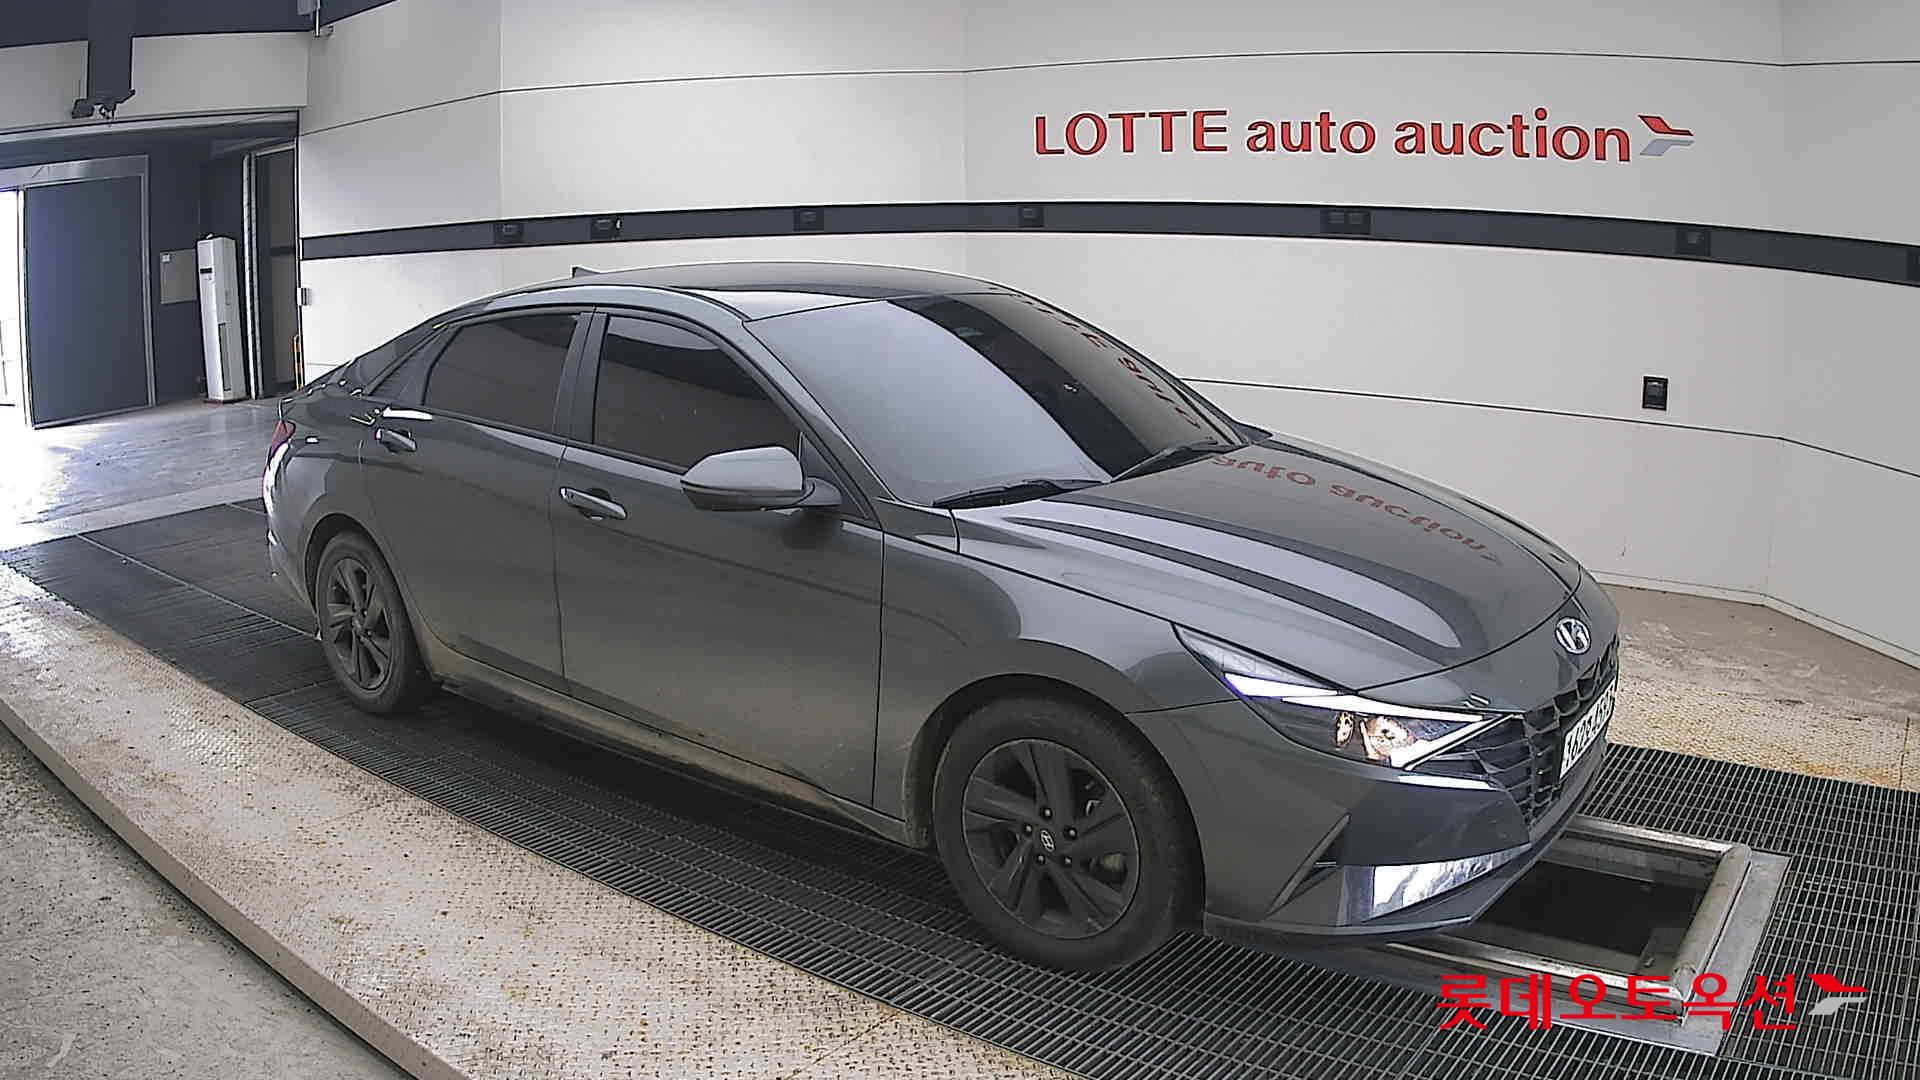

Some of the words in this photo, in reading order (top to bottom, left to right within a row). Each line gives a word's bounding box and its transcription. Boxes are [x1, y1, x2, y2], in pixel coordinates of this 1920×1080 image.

[1035, 110, 1228, 156] LOTTE
[1247, 111, 1376, 153] auto
[1396, 108, 1631, 162] auction
